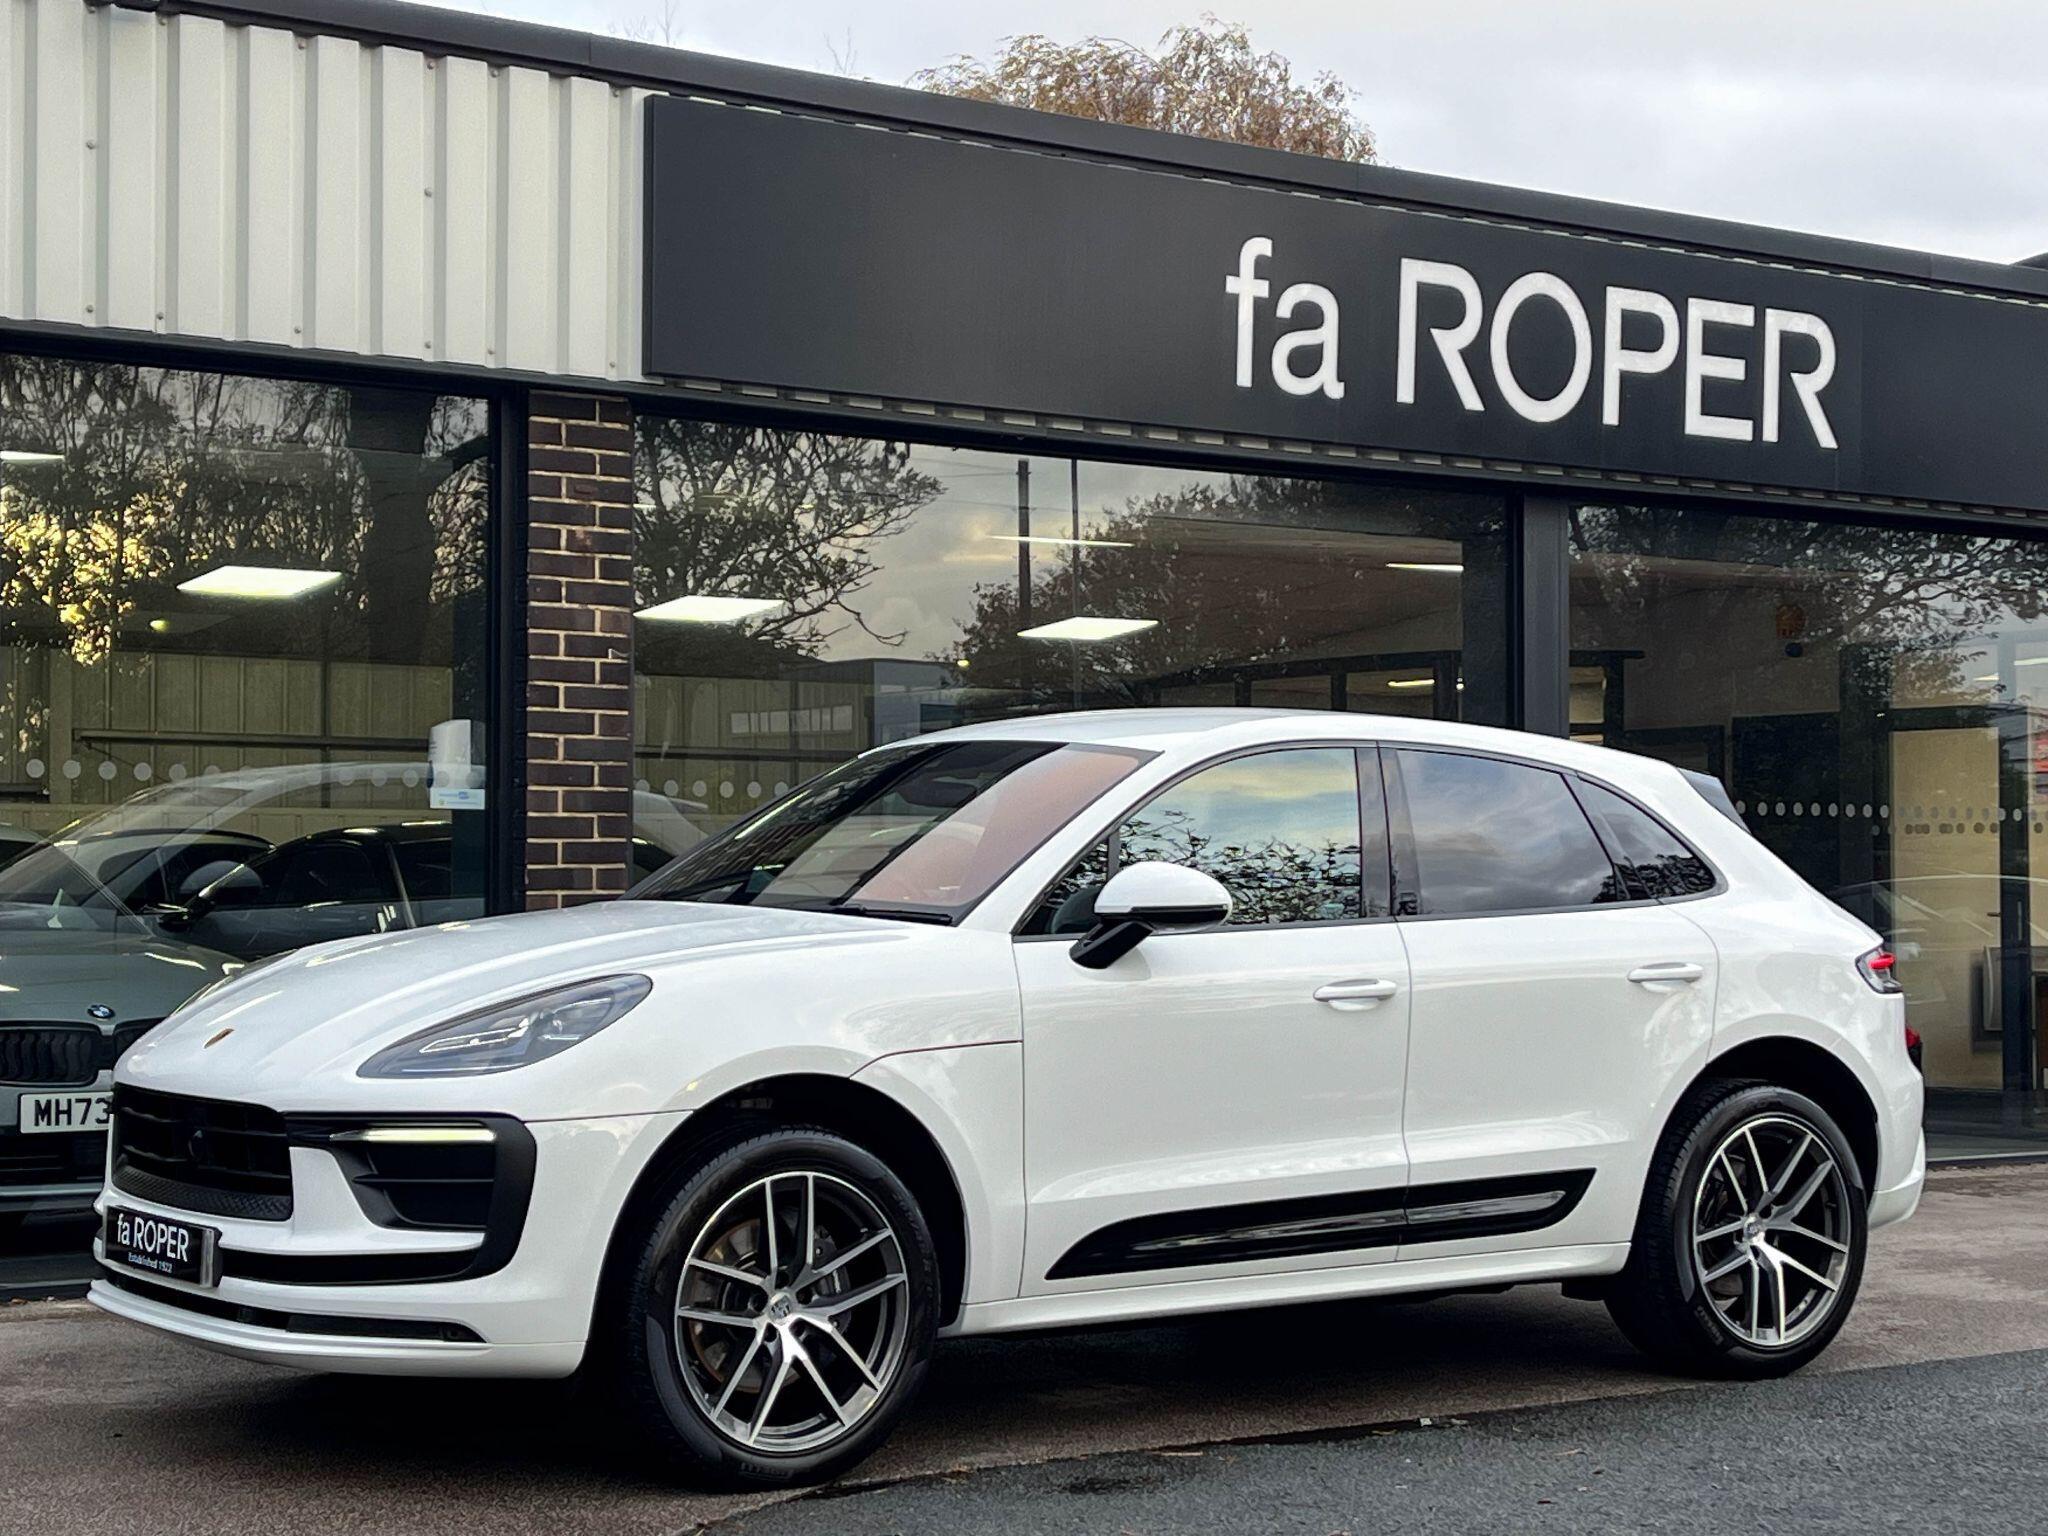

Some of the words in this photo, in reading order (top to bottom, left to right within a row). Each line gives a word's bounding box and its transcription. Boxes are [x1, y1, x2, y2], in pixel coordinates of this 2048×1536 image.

[1225, 236, 1345, 400] fa
[1396, 257, 1838, 450] ROPER
[34, 1097, 110, 1127] MH73
[117, 1213, 131, 1246] fa
[133, 1217, 189, 1262] ROPER
